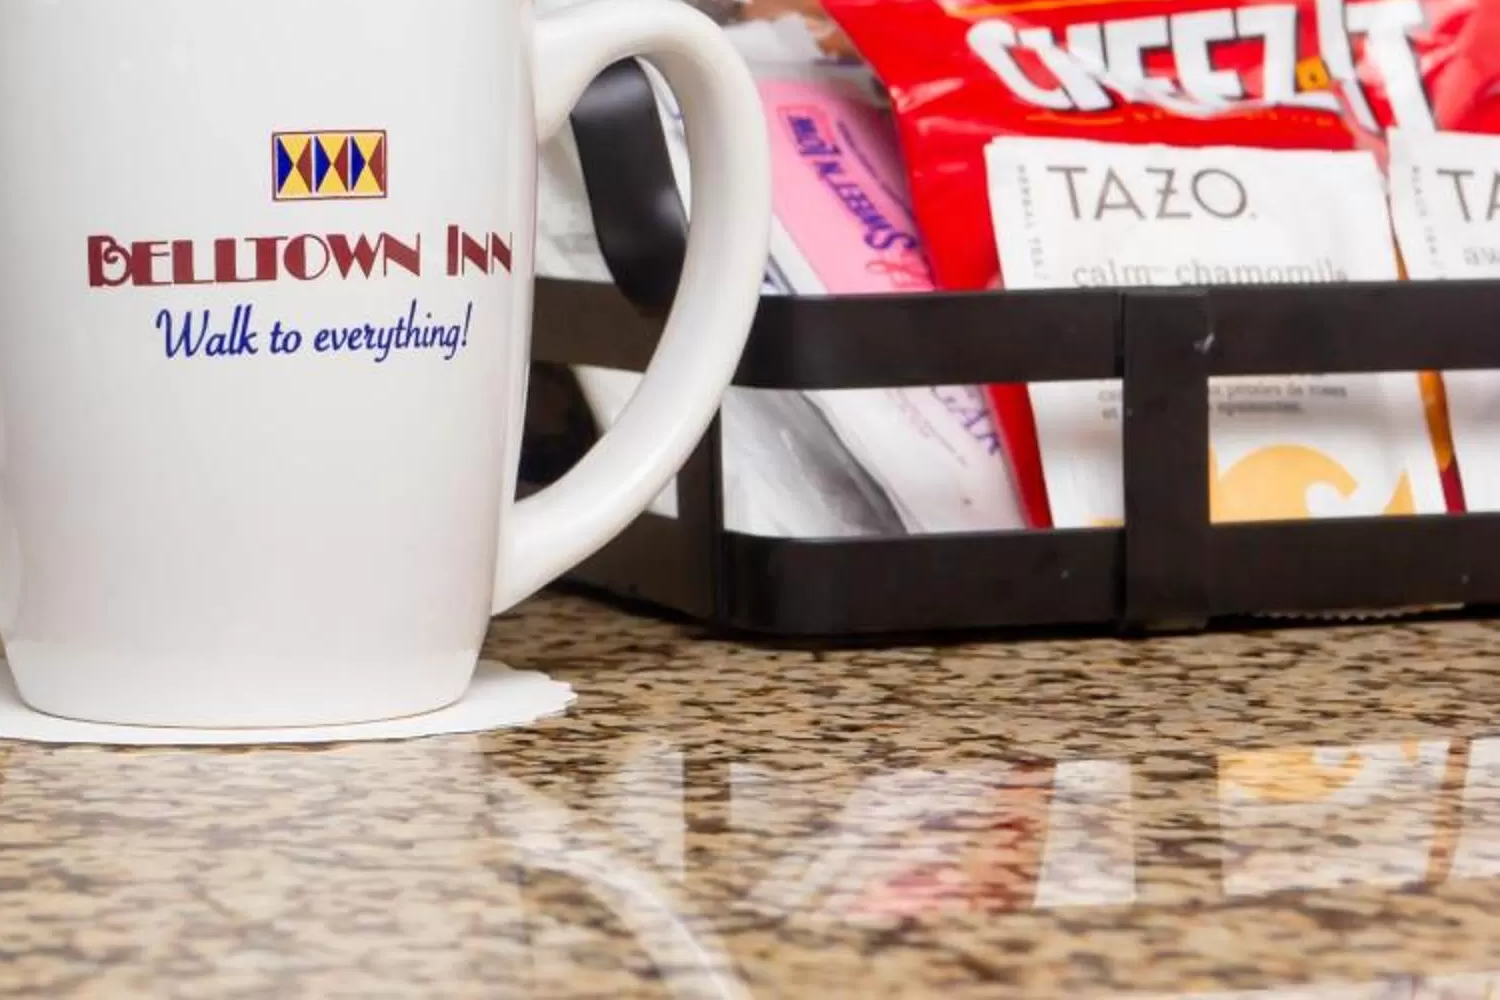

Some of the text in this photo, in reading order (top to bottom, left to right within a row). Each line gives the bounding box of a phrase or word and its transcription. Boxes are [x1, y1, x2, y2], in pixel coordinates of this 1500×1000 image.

[87, 232, 421, 288] BELLTOWN
[156, 298, 474, 363] Walk to everything!
